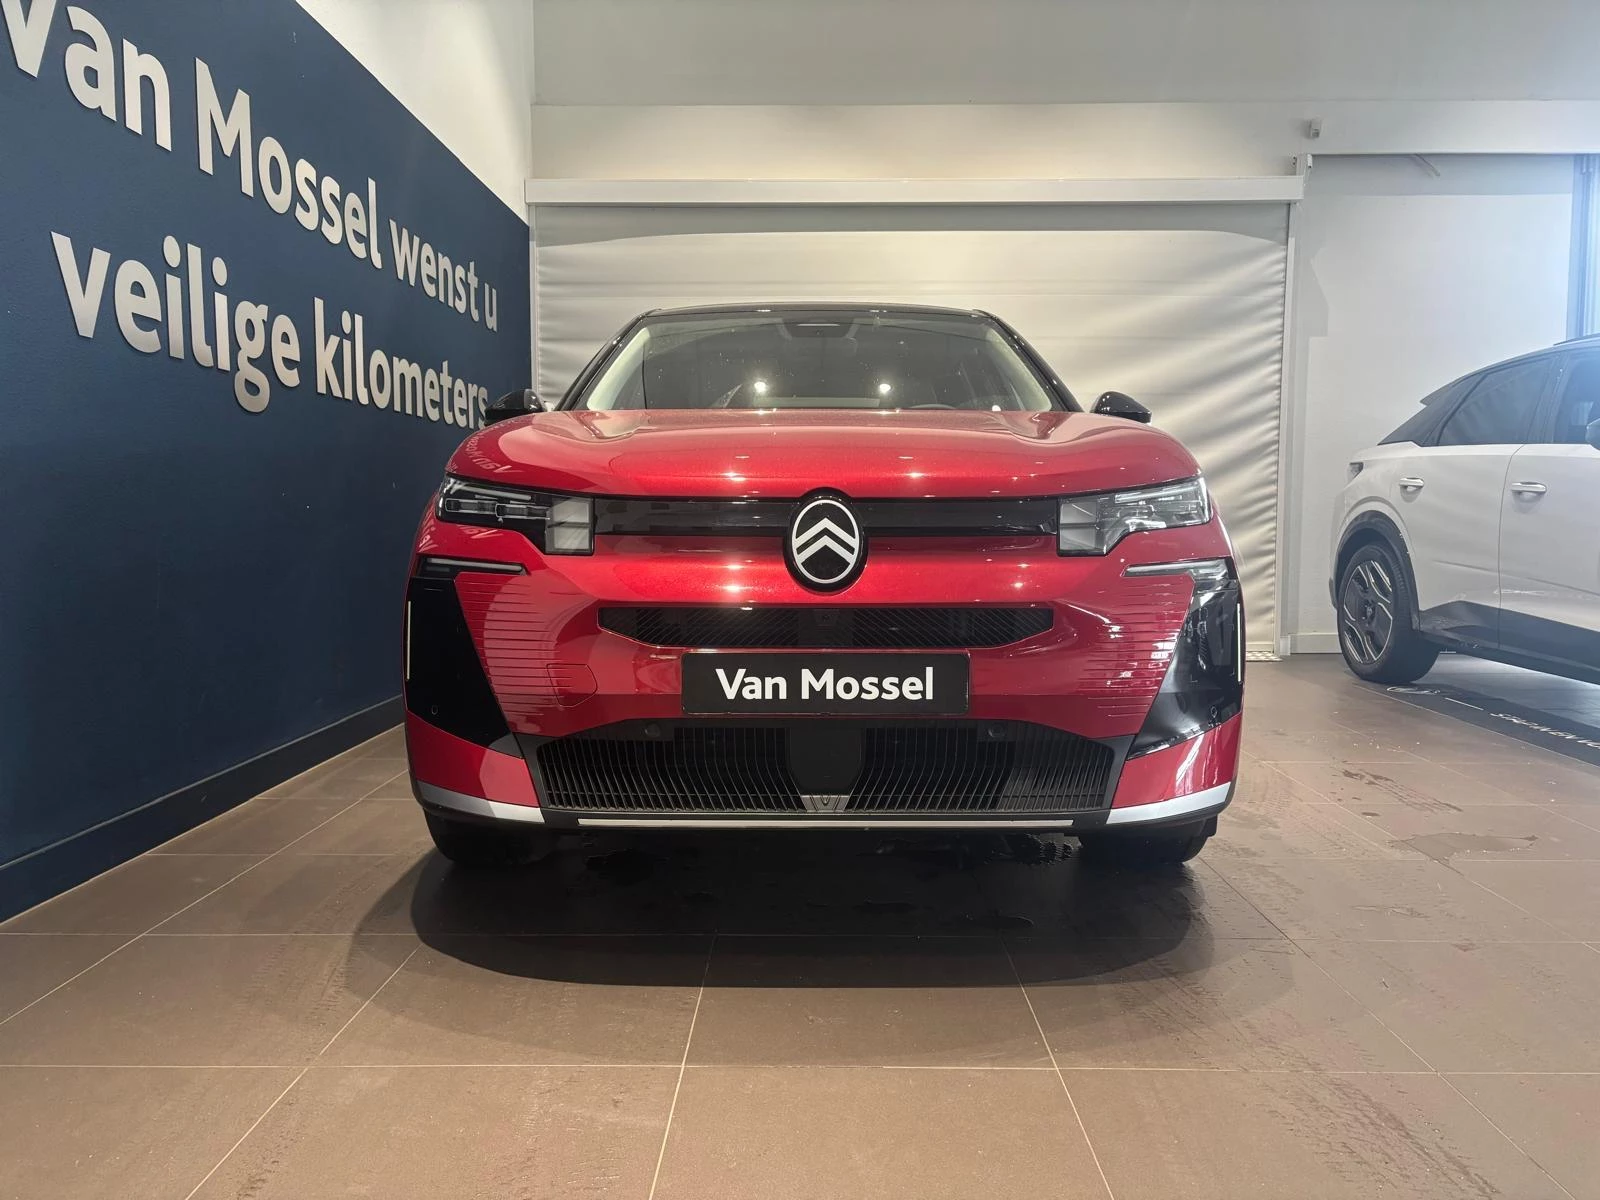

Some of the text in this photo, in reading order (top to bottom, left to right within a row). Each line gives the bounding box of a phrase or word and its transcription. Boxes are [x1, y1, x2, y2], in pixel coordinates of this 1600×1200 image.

[1, 0, 497, 332] Van Mossel wenst u
[50, 231, 488, 429] veilige kilometers
[715, 666, 934, 701] Van Mossel
